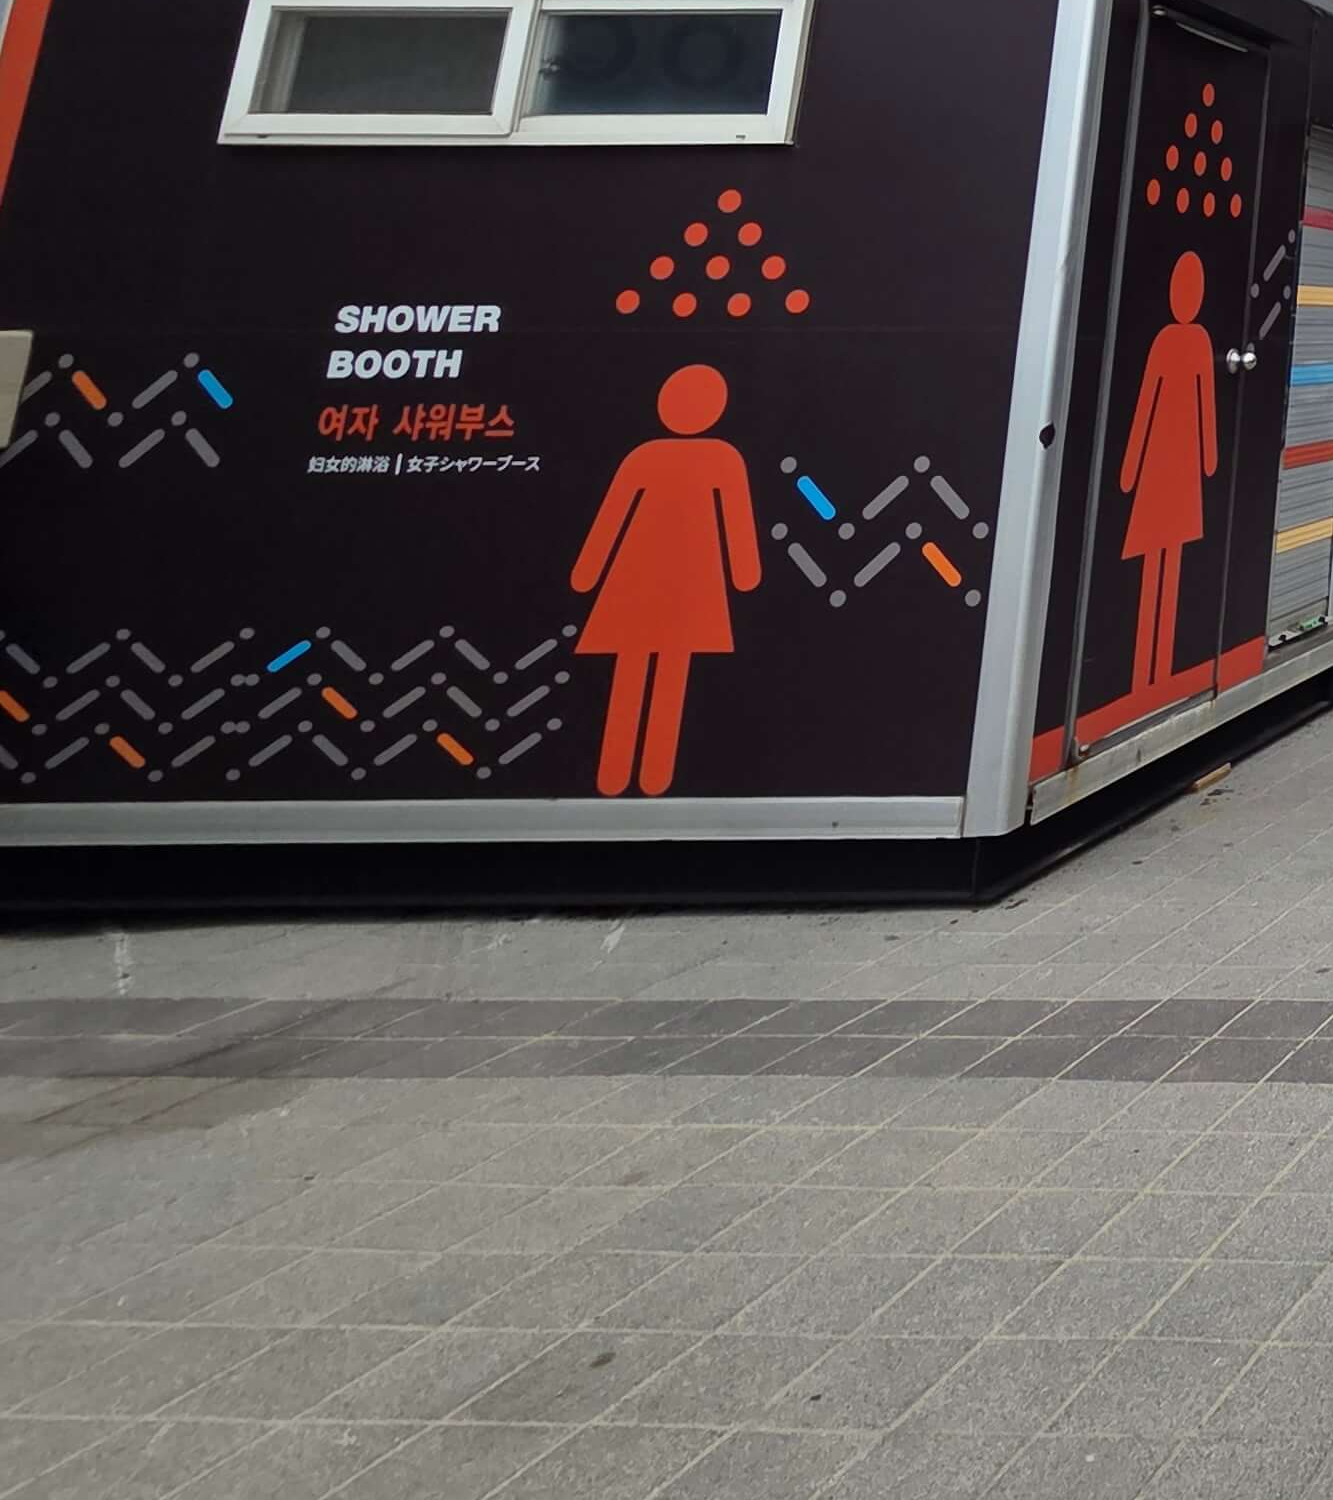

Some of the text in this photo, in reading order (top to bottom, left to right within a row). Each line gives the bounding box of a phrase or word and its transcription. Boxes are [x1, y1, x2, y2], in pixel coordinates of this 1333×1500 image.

[334, 304, 502, 333] SHOWER
[326, 349, 464, 379] BOOTH
[318, 403, 515, 442] 여자 샤워부스
[406, 455, 542, 473] 女子シャワーブース
